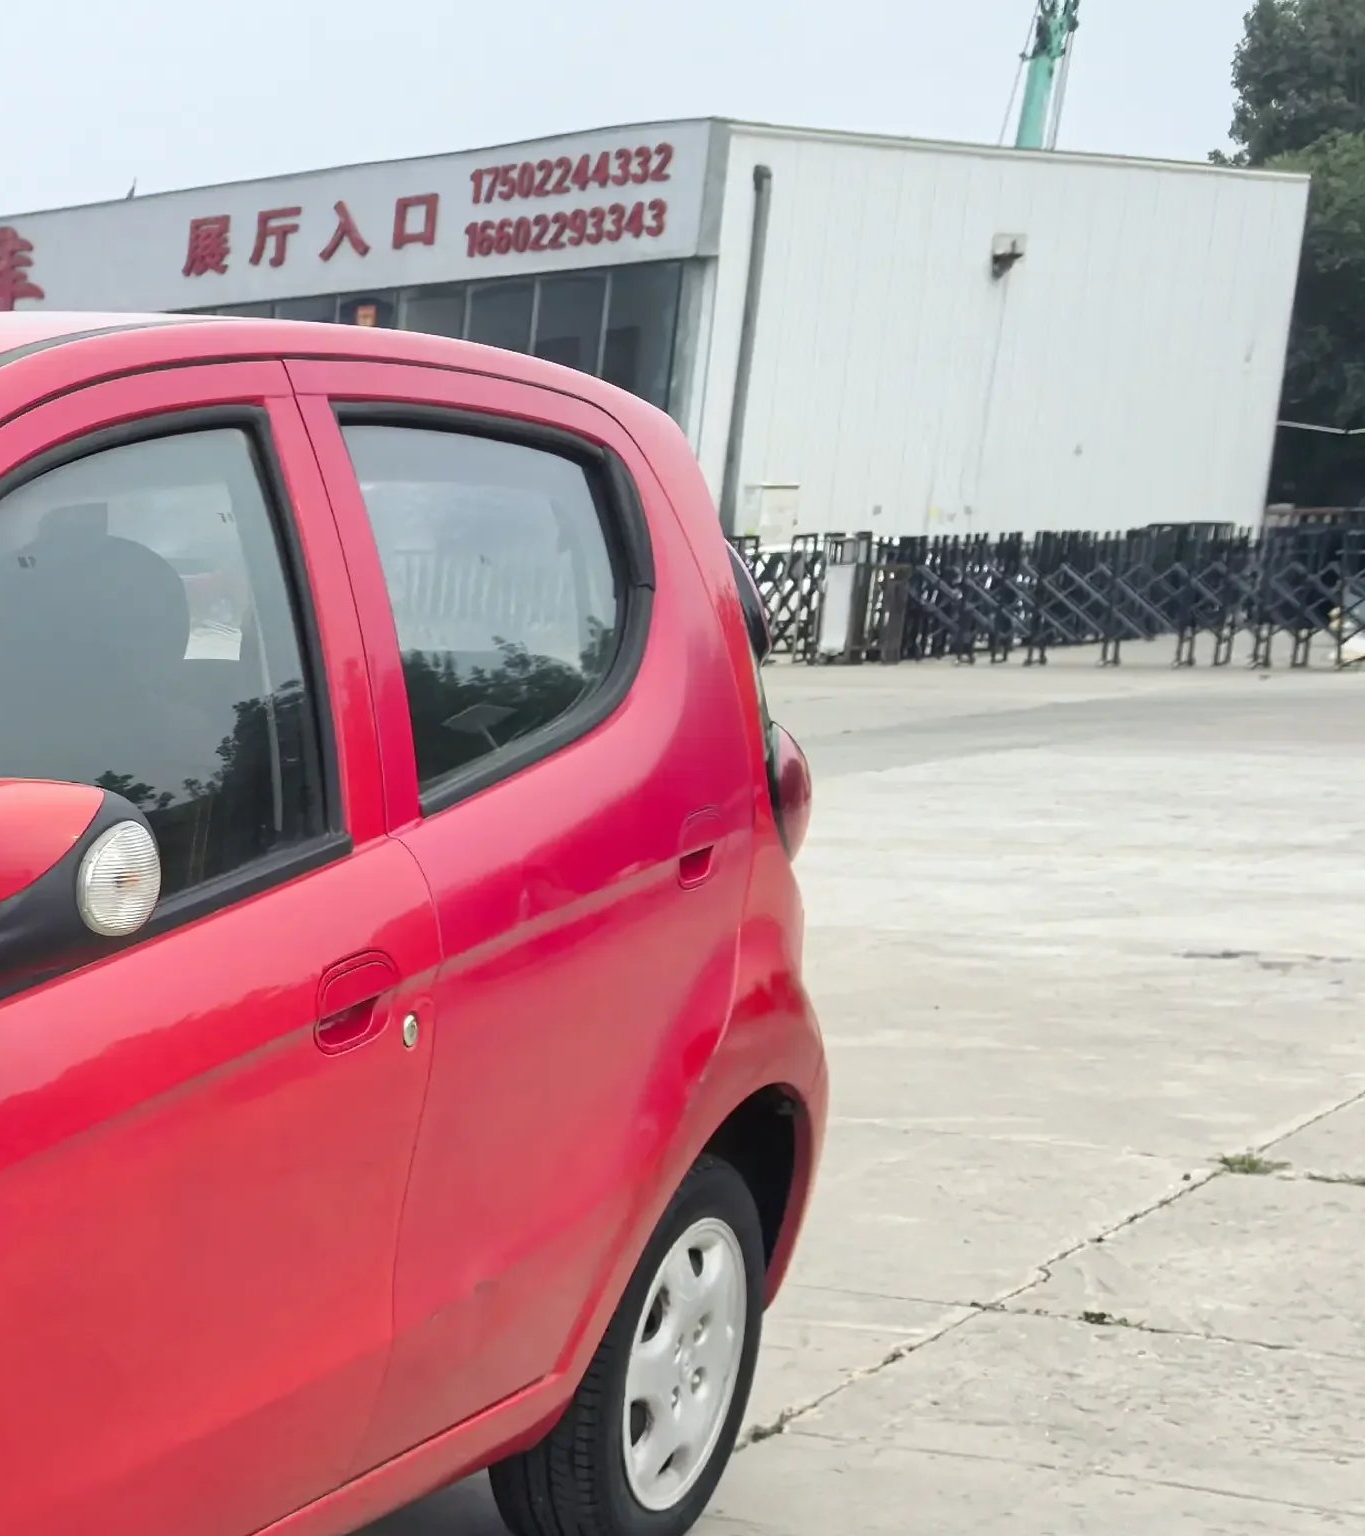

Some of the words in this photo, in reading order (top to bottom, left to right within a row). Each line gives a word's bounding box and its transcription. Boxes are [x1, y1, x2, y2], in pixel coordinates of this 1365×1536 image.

[469, 142, 674, 205] 17502244332
[181, 192, 440, 278] 展厅入口
[464, 198, 668, 258] 16602293343
